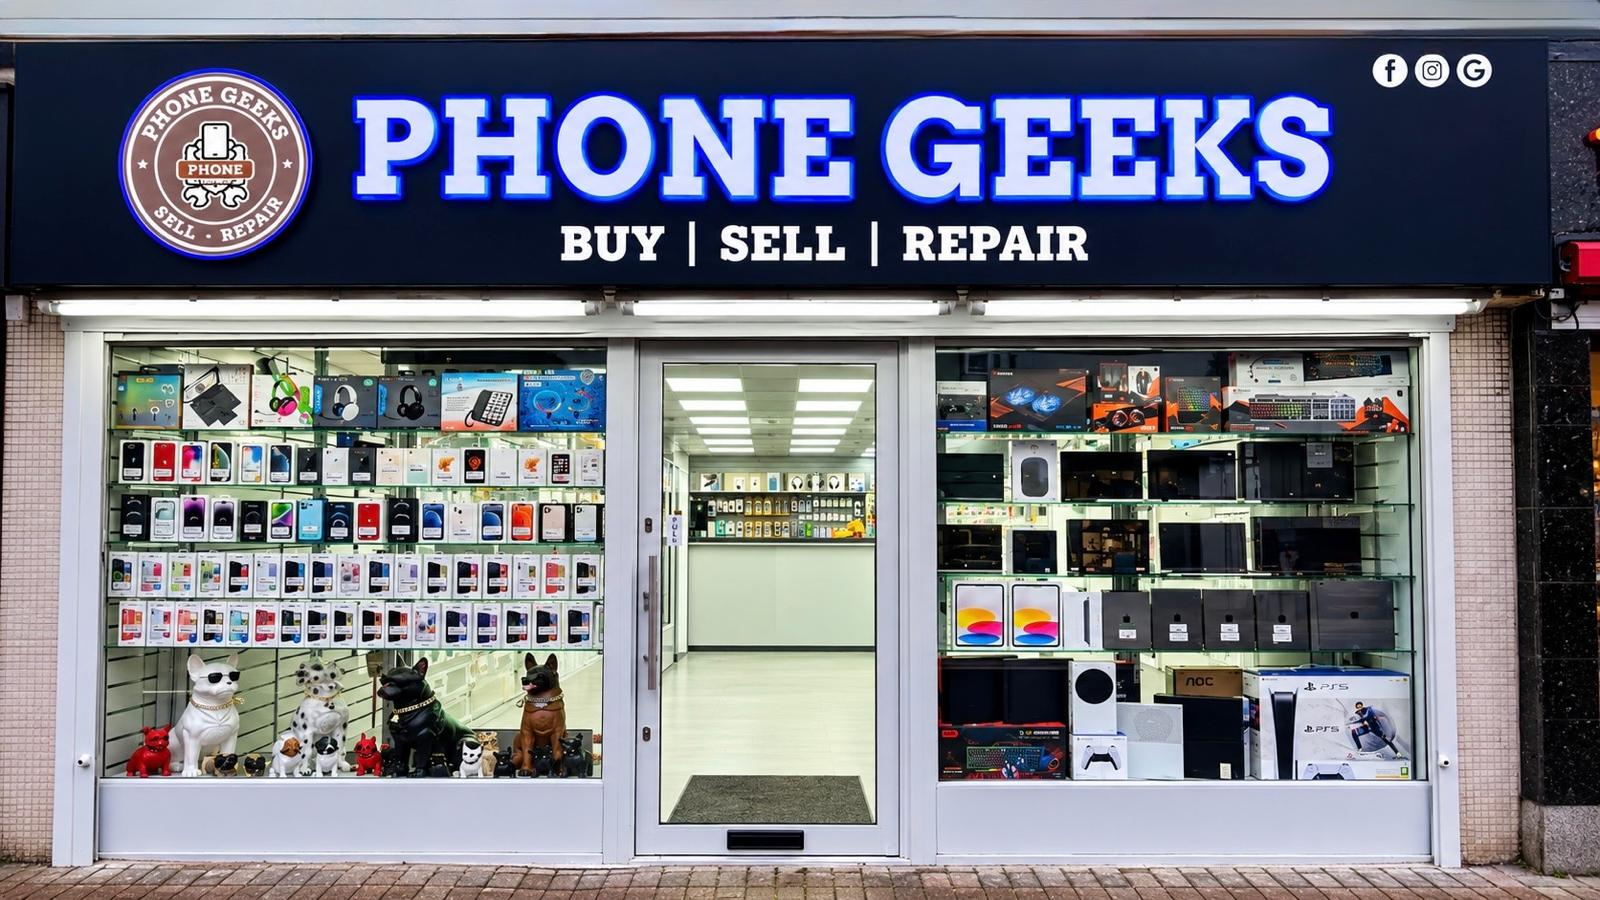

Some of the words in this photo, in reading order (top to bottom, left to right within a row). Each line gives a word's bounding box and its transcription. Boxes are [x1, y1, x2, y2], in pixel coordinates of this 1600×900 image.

[141, 86, 214, 142] PHONE
[220, 86, 289, 141] GEEKS
[187, 163, 244, 176] PHONE
[355, 96, 852, 198] PHONE
[884, 95, 1331, 199] GEEKS
[154, 205, 196, 240] SELL
[220, 196, 284, 242] REPAIR
[560, 225, 665, 262] BUY
[720, 224, 846, 262] SELL
[902, 225, 1089, 262] REPAIR
